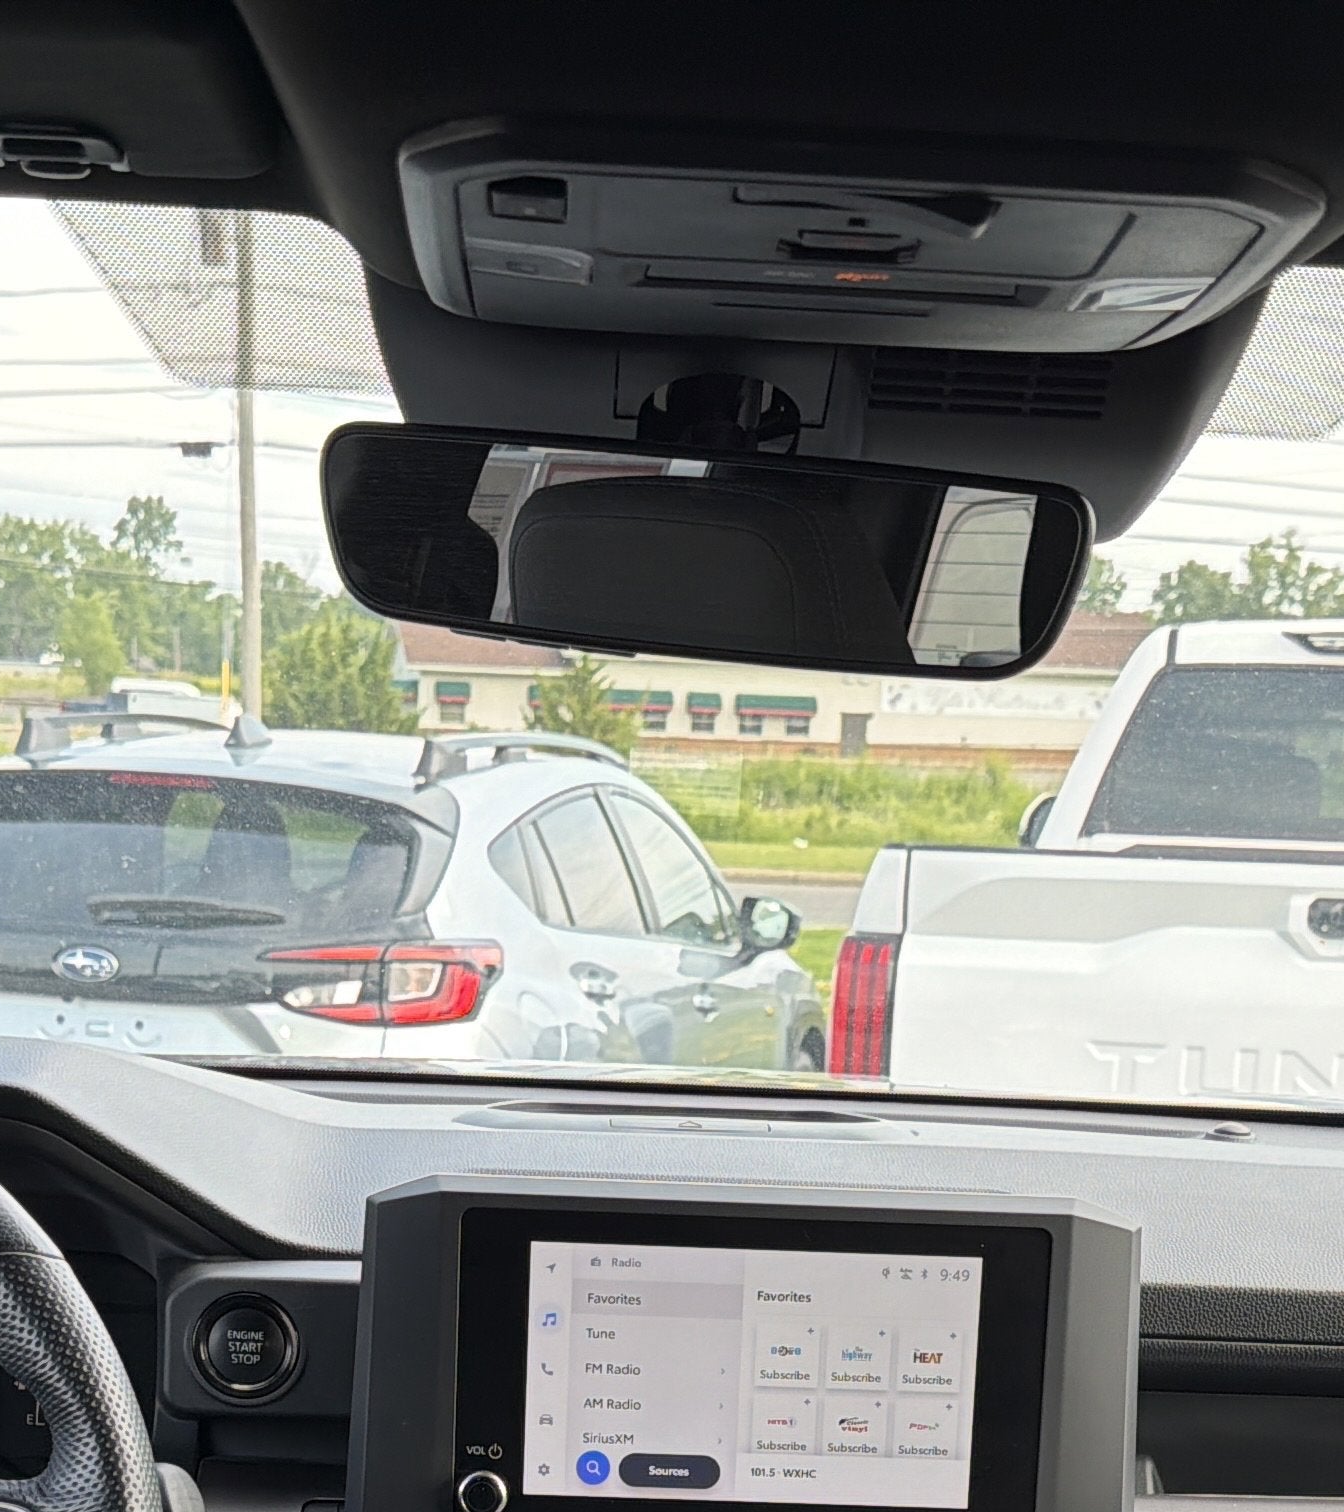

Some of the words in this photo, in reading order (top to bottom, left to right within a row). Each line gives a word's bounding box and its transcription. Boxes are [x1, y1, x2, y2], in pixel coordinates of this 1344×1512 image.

[611, 1257, 642, 1268] Radio
[939, 1268, 971, 1282] 9:49
[587, 1292, 642, 1306] Favorites
[757, 1290, 812, 1303] Favorites
[227, 1330, 264, 1340] ENGINE
[586, 1327, 616, 1340] Tune
[228, 1341, 263, 1352] START
[231, 1353, 261, 1364] STOP
[912, 1352, 943, 1364] HEAT
[585, 1363, 603, 1374] FM
[606, 1364, 641, 1376] Radio
[760, 1370, 810, 1381] Subscribe
[831, 1372, 882, 1384] Subscribe
[902, 1374, 953, 1386] Subscribe
[583, 1398, 603, 1409] AM
[607, 1399, 642, 1411] Radio
[26, 1413, 35, 1425] E
[582, 1432, 634, 1445] SiriusXM
[466, 1445, 486, 1456] VOL
[756, 1440, 807, 1451] Subscribe
[827, 1442, 878, 1454] Subscribe
[898, 1445, 949, 1456] Subscribe
[648, 1465, 690, 1476] Sources
[751, 1467, 775, 1478] 101.5
[783, 1468, 817, 1479] WXHC
